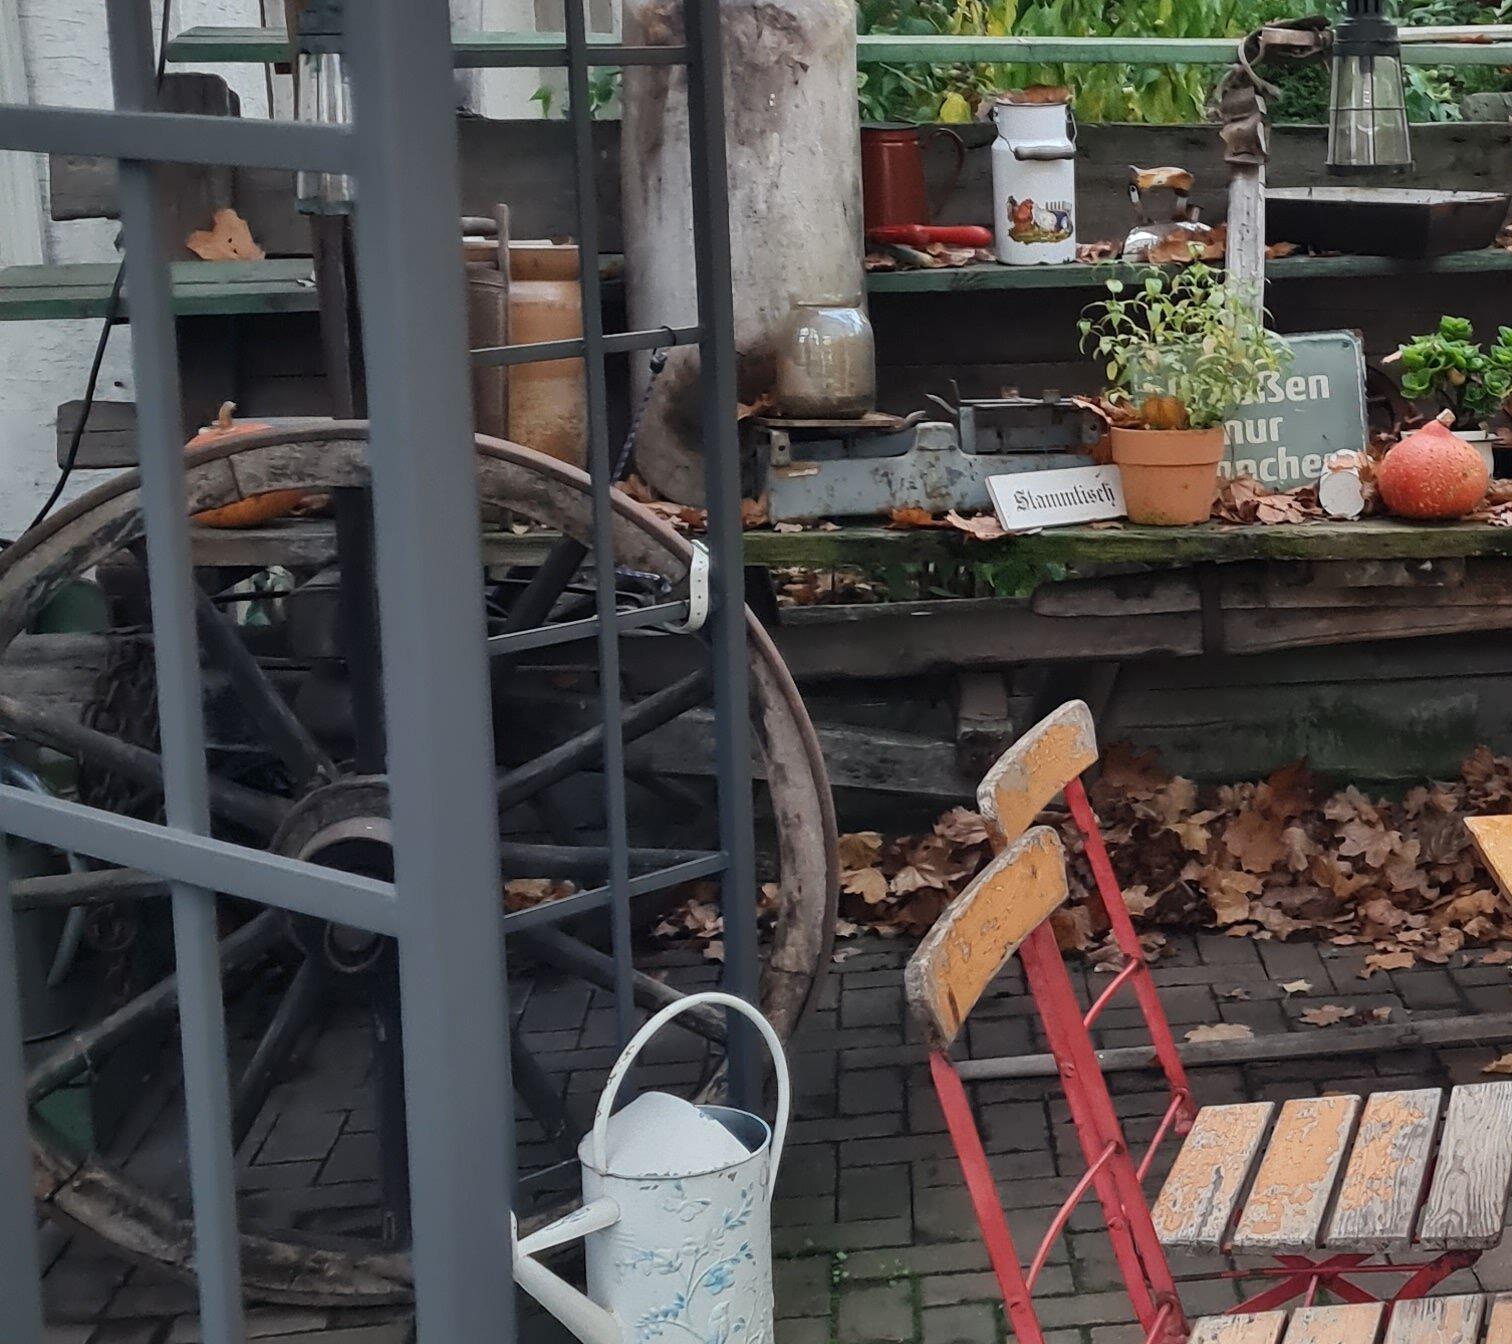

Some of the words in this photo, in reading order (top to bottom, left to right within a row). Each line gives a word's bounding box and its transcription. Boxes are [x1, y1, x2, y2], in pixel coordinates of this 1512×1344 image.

[1240, 370, 1330, 405] ßen
[1224, 416, 1284, 446] nur
[1014, 482, 1116, 512] Stammtisch
